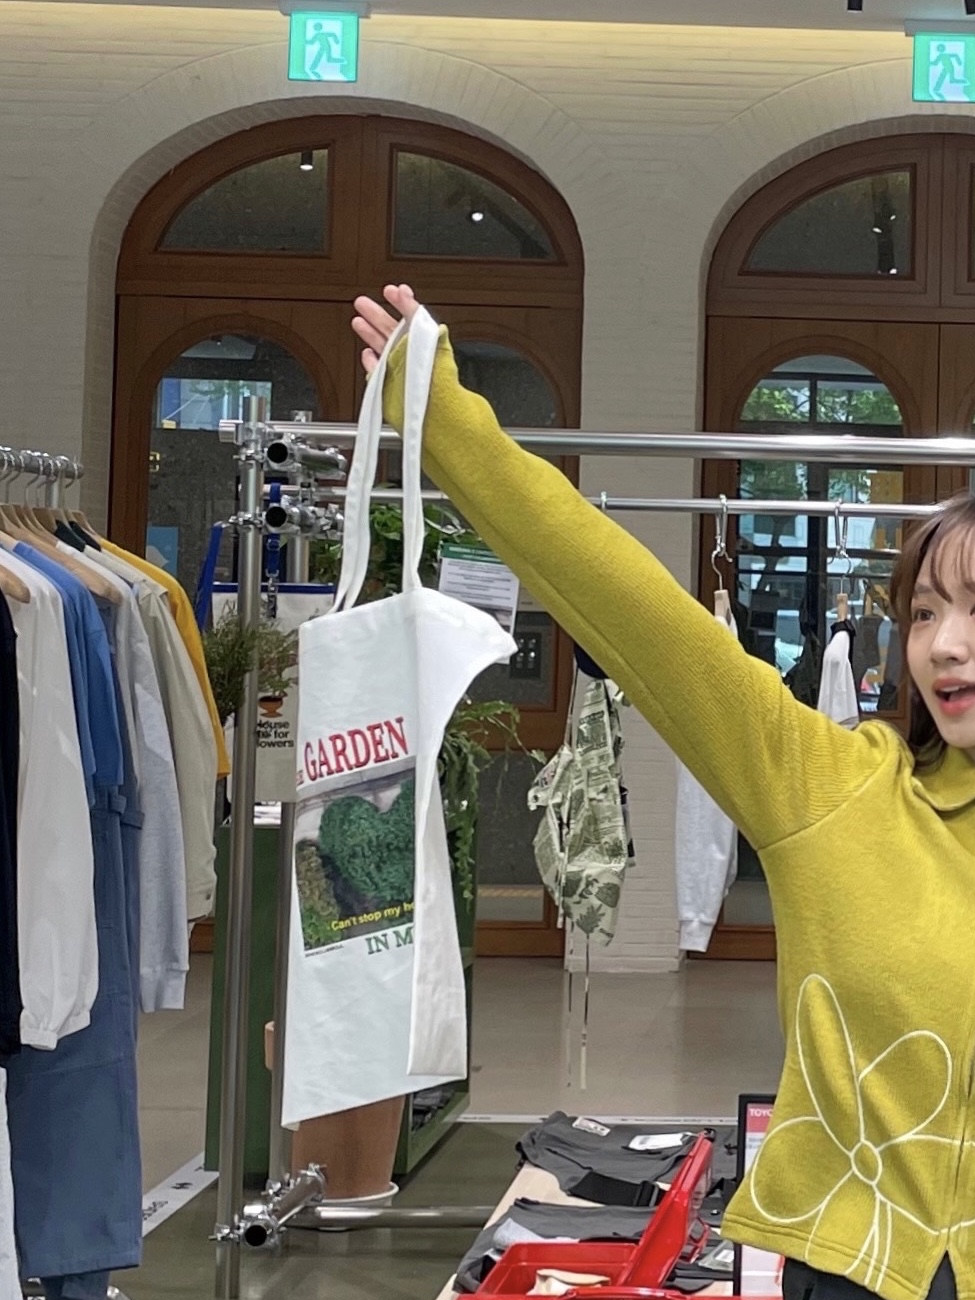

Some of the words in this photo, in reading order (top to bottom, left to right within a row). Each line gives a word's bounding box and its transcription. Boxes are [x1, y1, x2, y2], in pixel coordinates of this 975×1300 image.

[304, 716, 409, 781] GARDEN
[358, 909, 382, 924] stop
[384, 904, 400, 918] my
[365, 933, 390, 955] IN
